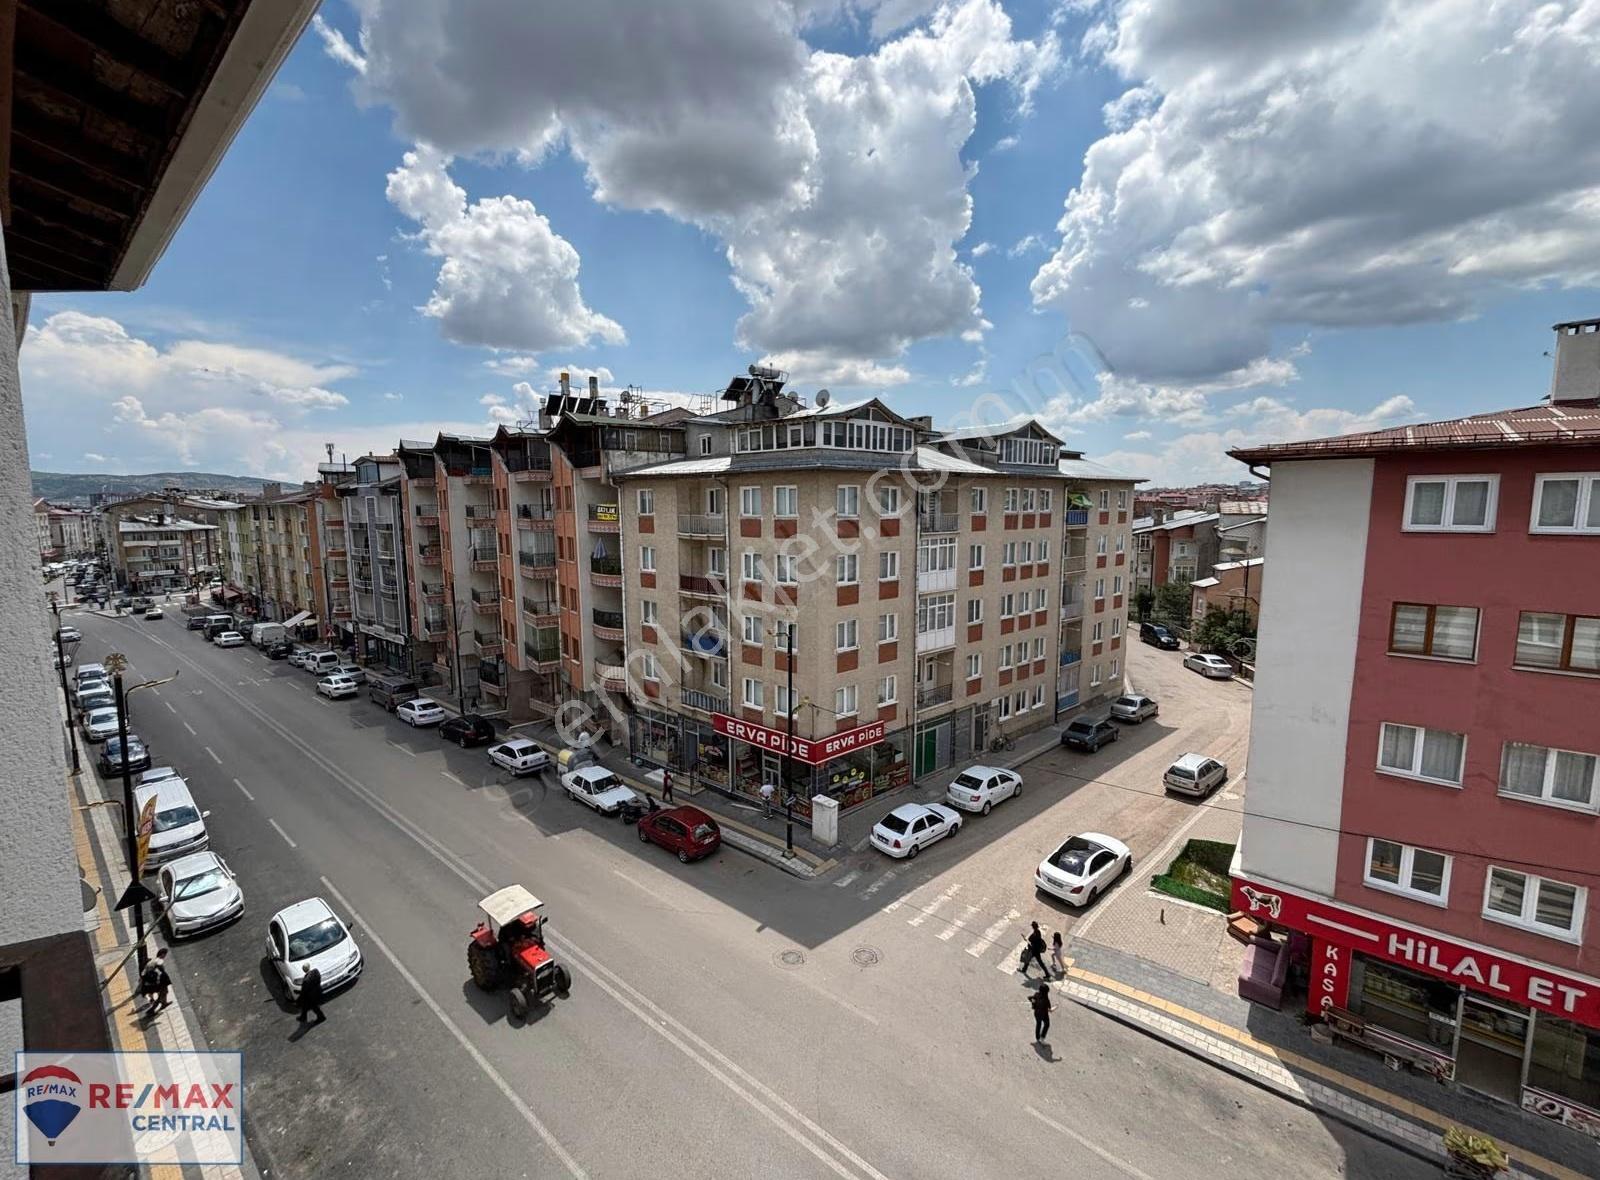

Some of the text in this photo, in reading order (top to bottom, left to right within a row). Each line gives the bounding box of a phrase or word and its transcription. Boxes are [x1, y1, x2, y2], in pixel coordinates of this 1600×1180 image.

[726, 721, 767, 745] ERVA
[825, 727, 883, 753] ERVA PİDE
[1320, 945, 1339, 1019] KASA
[1528, 976, 1587, 1012] ET
